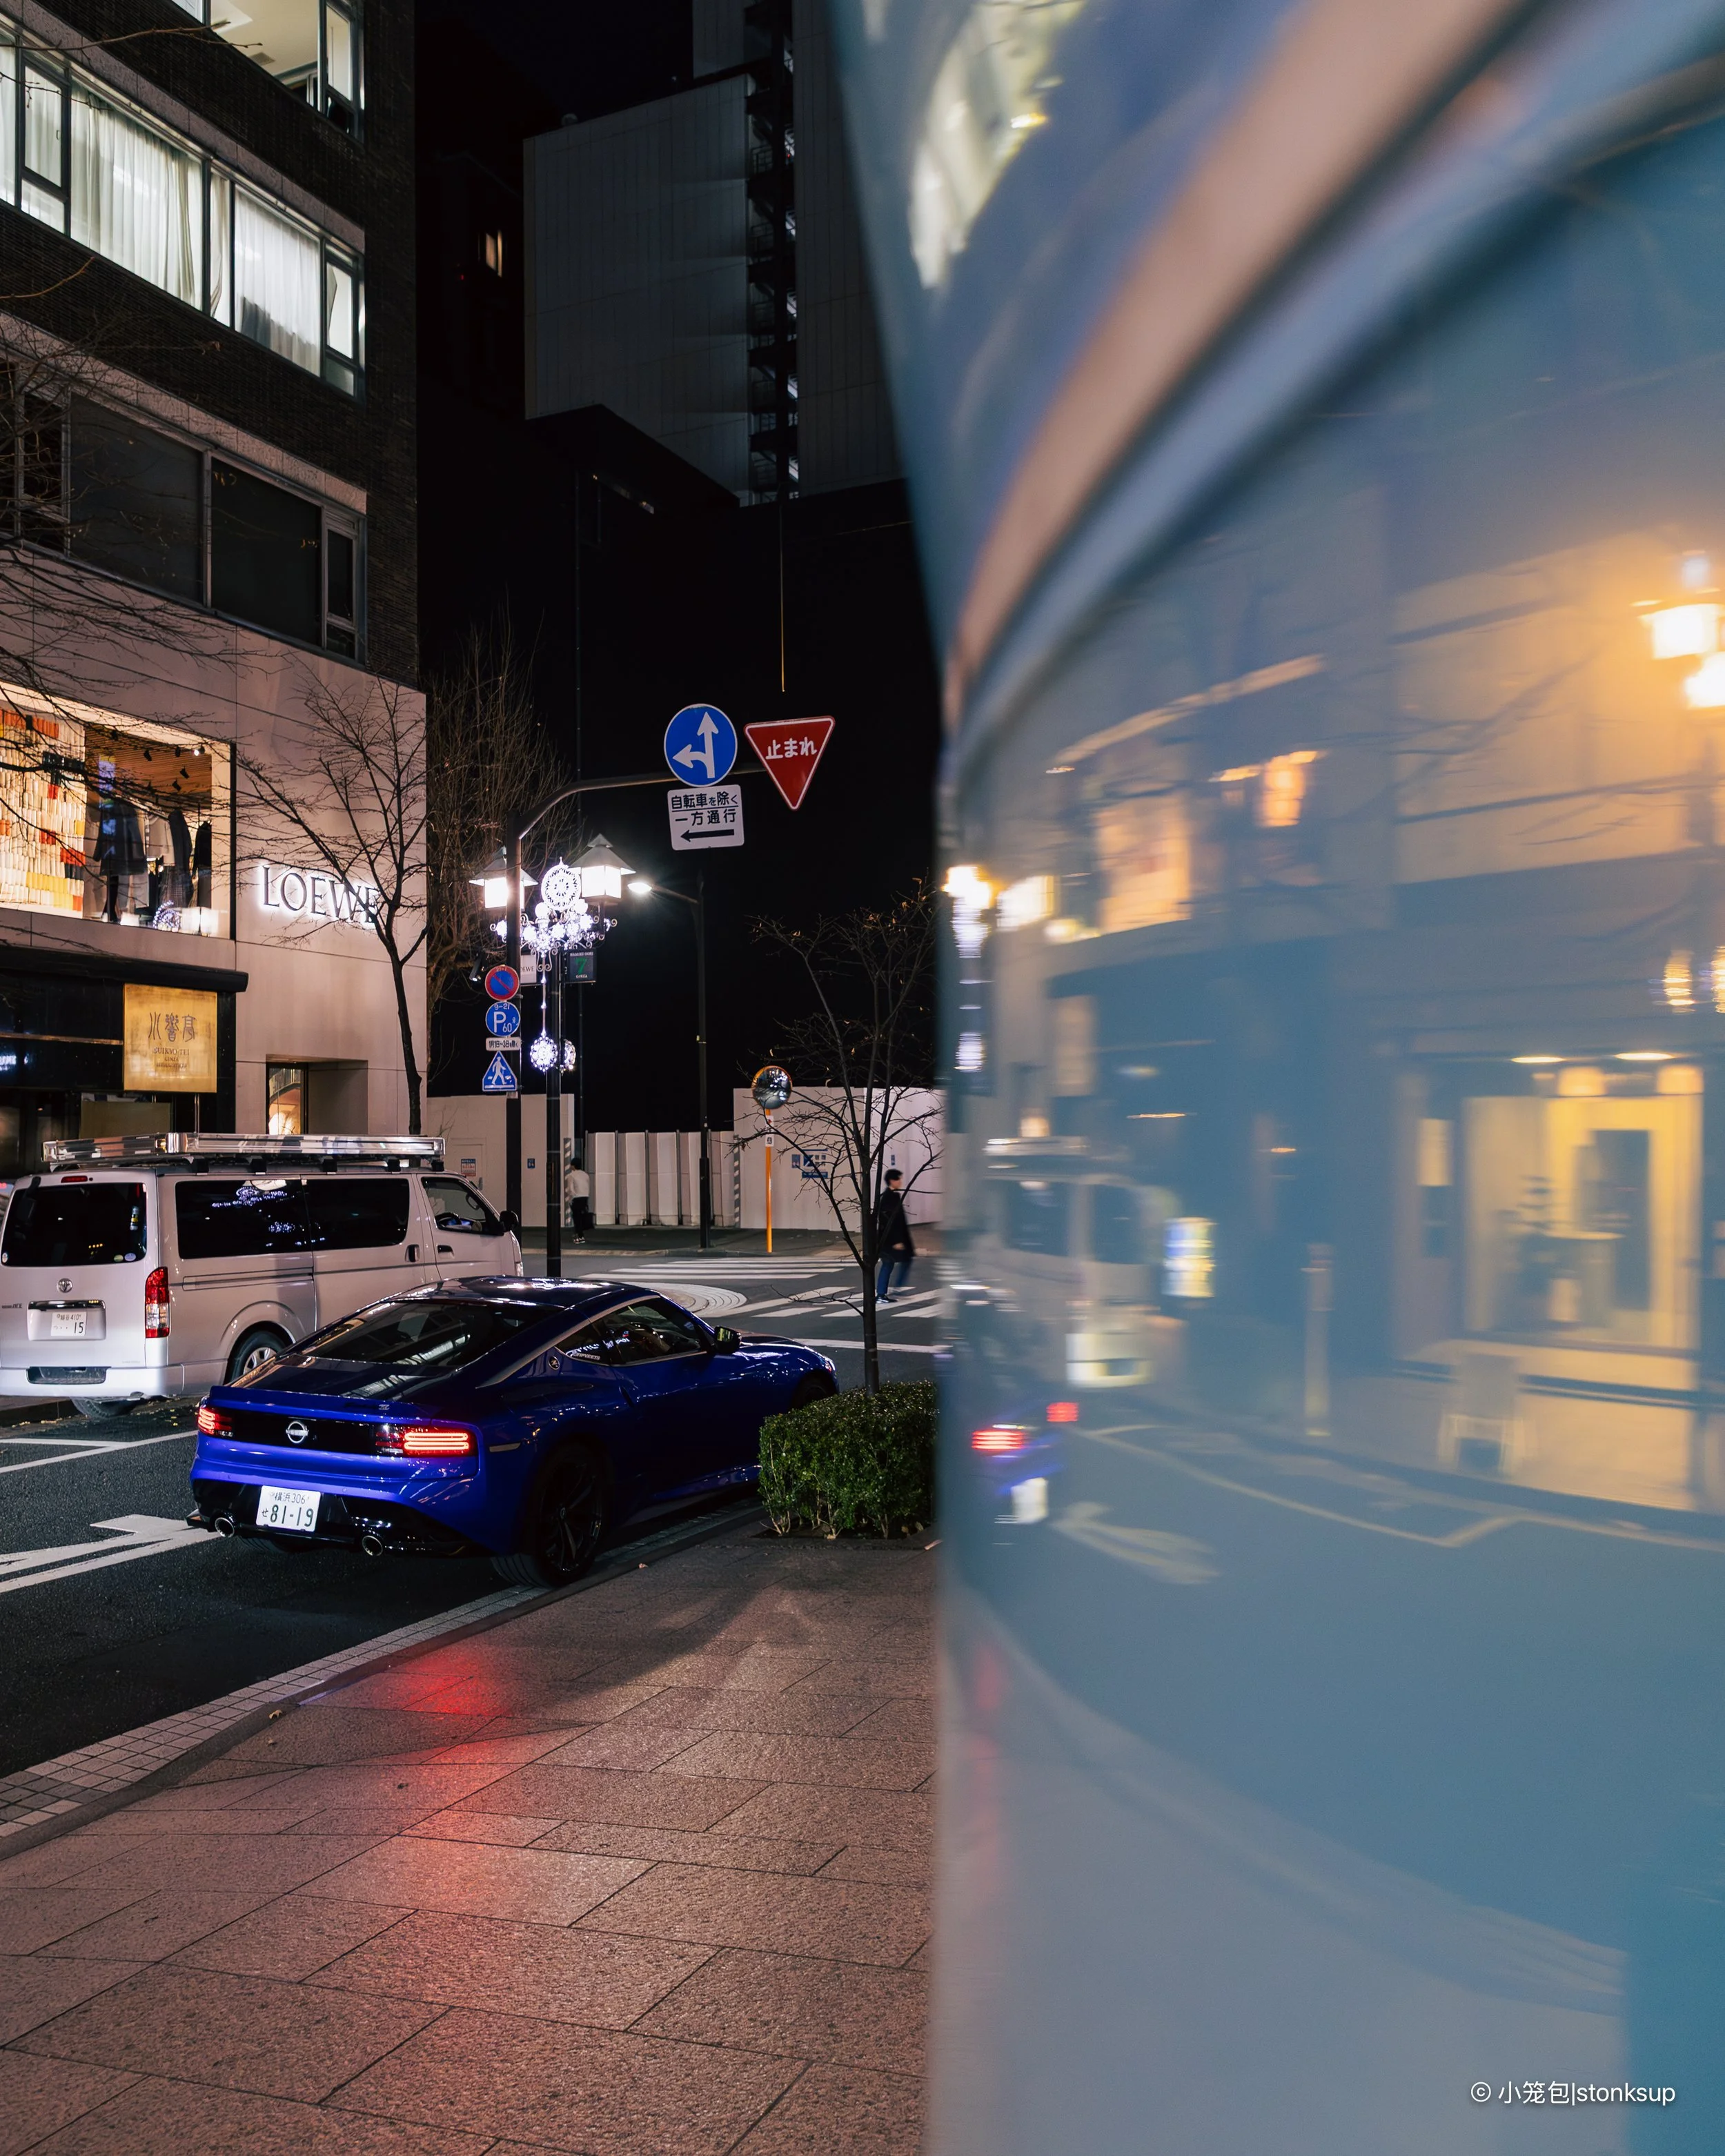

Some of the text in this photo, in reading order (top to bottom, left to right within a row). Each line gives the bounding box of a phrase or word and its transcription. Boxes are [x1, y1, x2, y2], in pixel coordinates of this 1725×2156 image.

[765, 736, 818, 760] 止まれ
[671, 791, 738, 810] 自転車を除く
[675, 809, 737, 826] 一方通行
[262, 865, 379, 923] LOEWE
[574, 957, 587, 974] 7
[494, 1002, 510, 1011] 9-21
[493, 1011, 506, 1033] P
[275, 1492, 306, 1505] 横浜 306
[270, 1504, 314, 1527] 81-19
